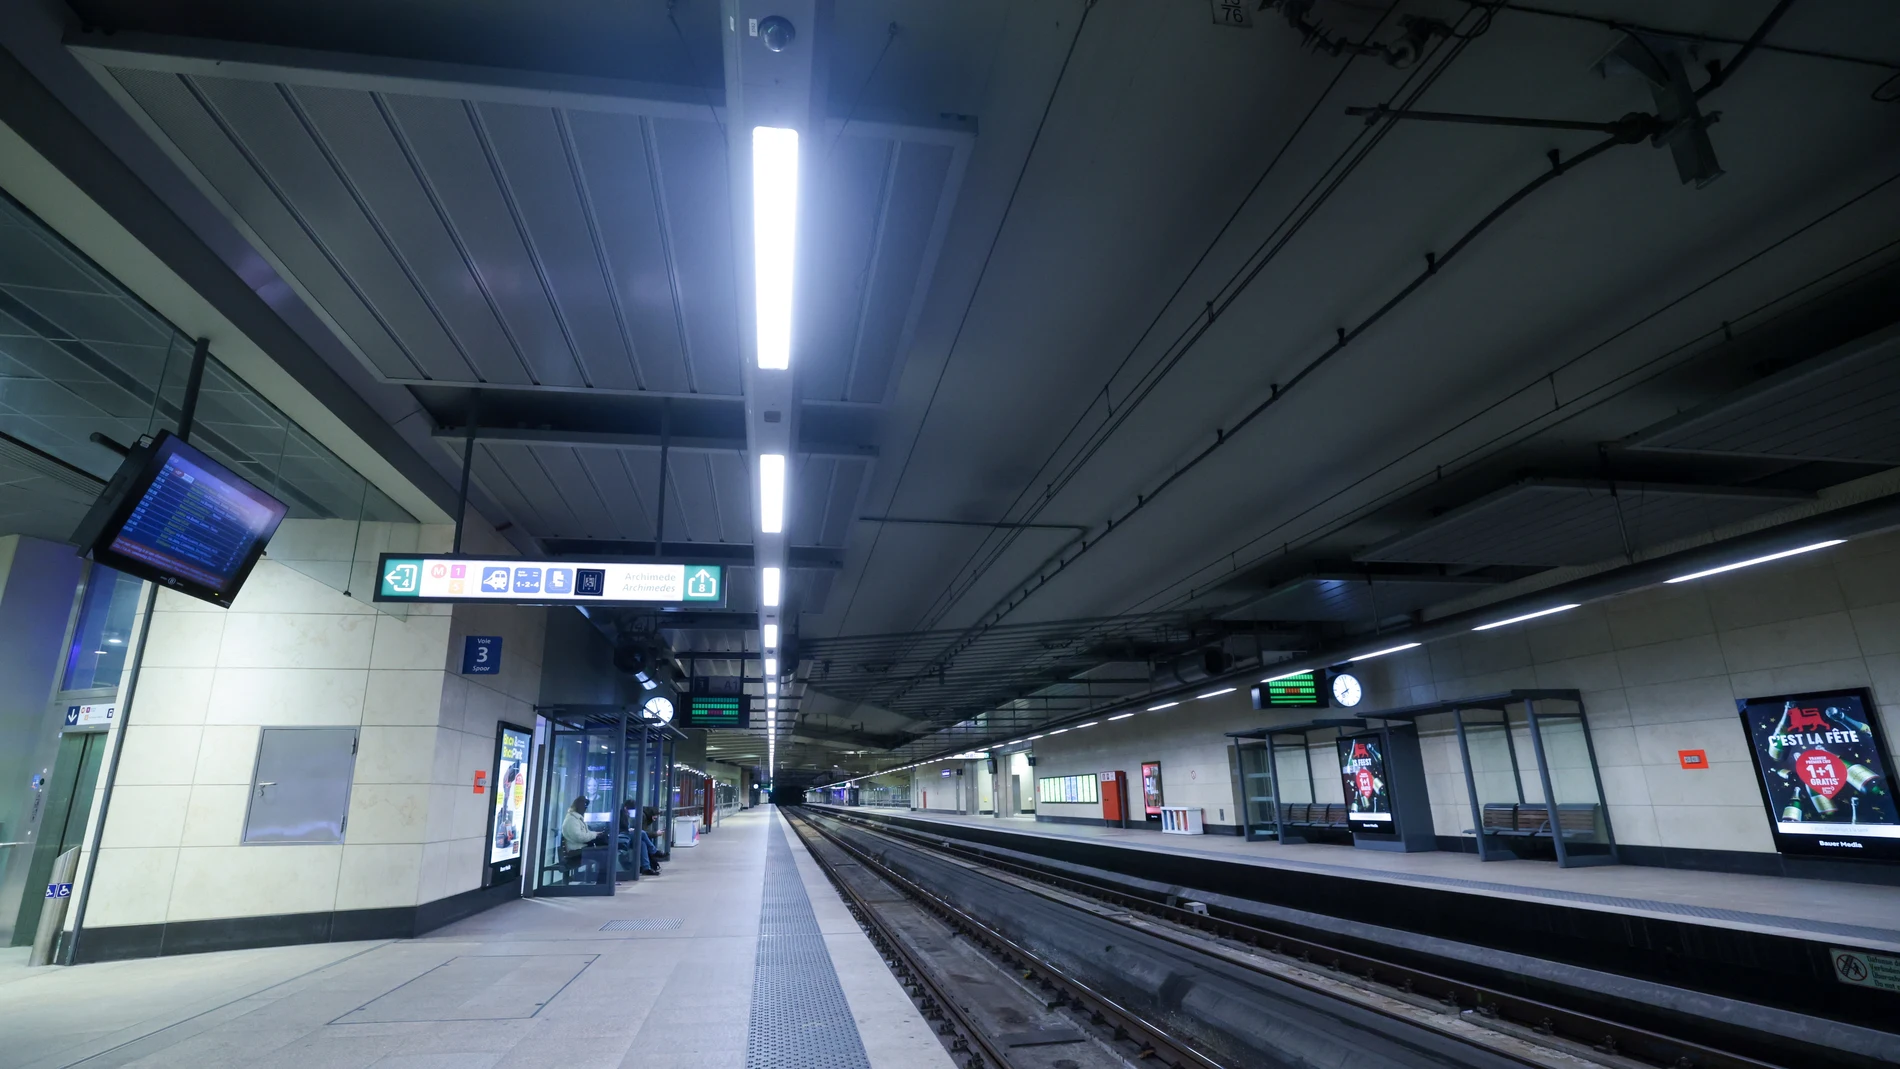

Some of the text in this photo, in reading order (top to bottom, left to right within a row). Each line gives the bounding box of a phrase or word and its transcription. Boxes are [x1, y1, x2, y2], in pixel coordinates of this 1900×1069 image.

[1222, 7, 1243, 23] 76
[404, 568, 410, 578] 1
[434, 567, 444, 576] M
[624, 572, 676, 582] Archimede
[622, 583, 676, 593] Archimedes
[699, 584, 706, 592] 8
[476, 646, 489, 663] 3
[1768, 728, 1859, 747] C'EST LA FÊTE
[1806, 763, 1836, 779] 1+1
